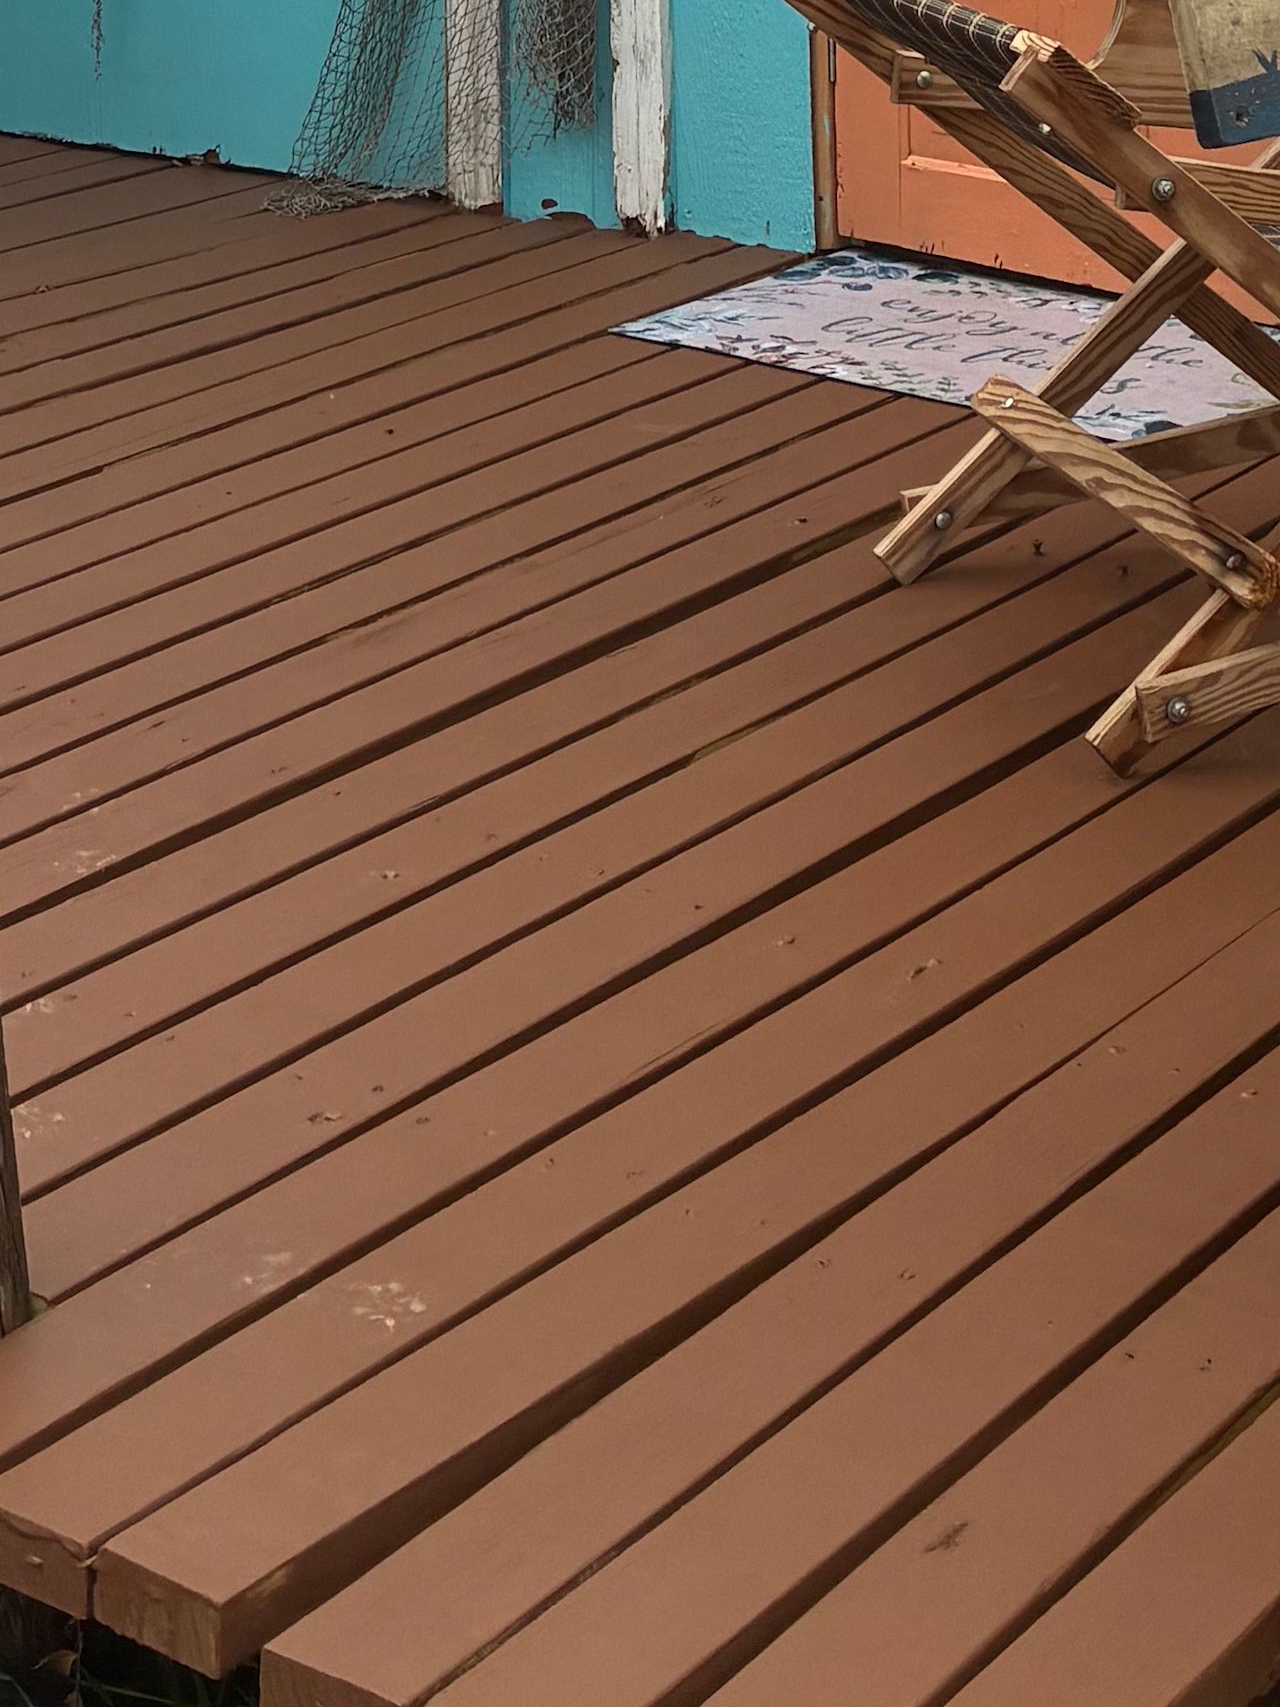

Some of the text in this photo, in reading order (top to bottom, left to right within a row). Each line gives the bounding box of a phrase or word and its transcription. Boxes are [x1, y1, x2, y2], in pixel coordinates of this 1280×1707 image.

[821, 316, 957, 352] little
[881, 298, 1021, 336] enjoy
[1029, 331, 1087, 346] al
